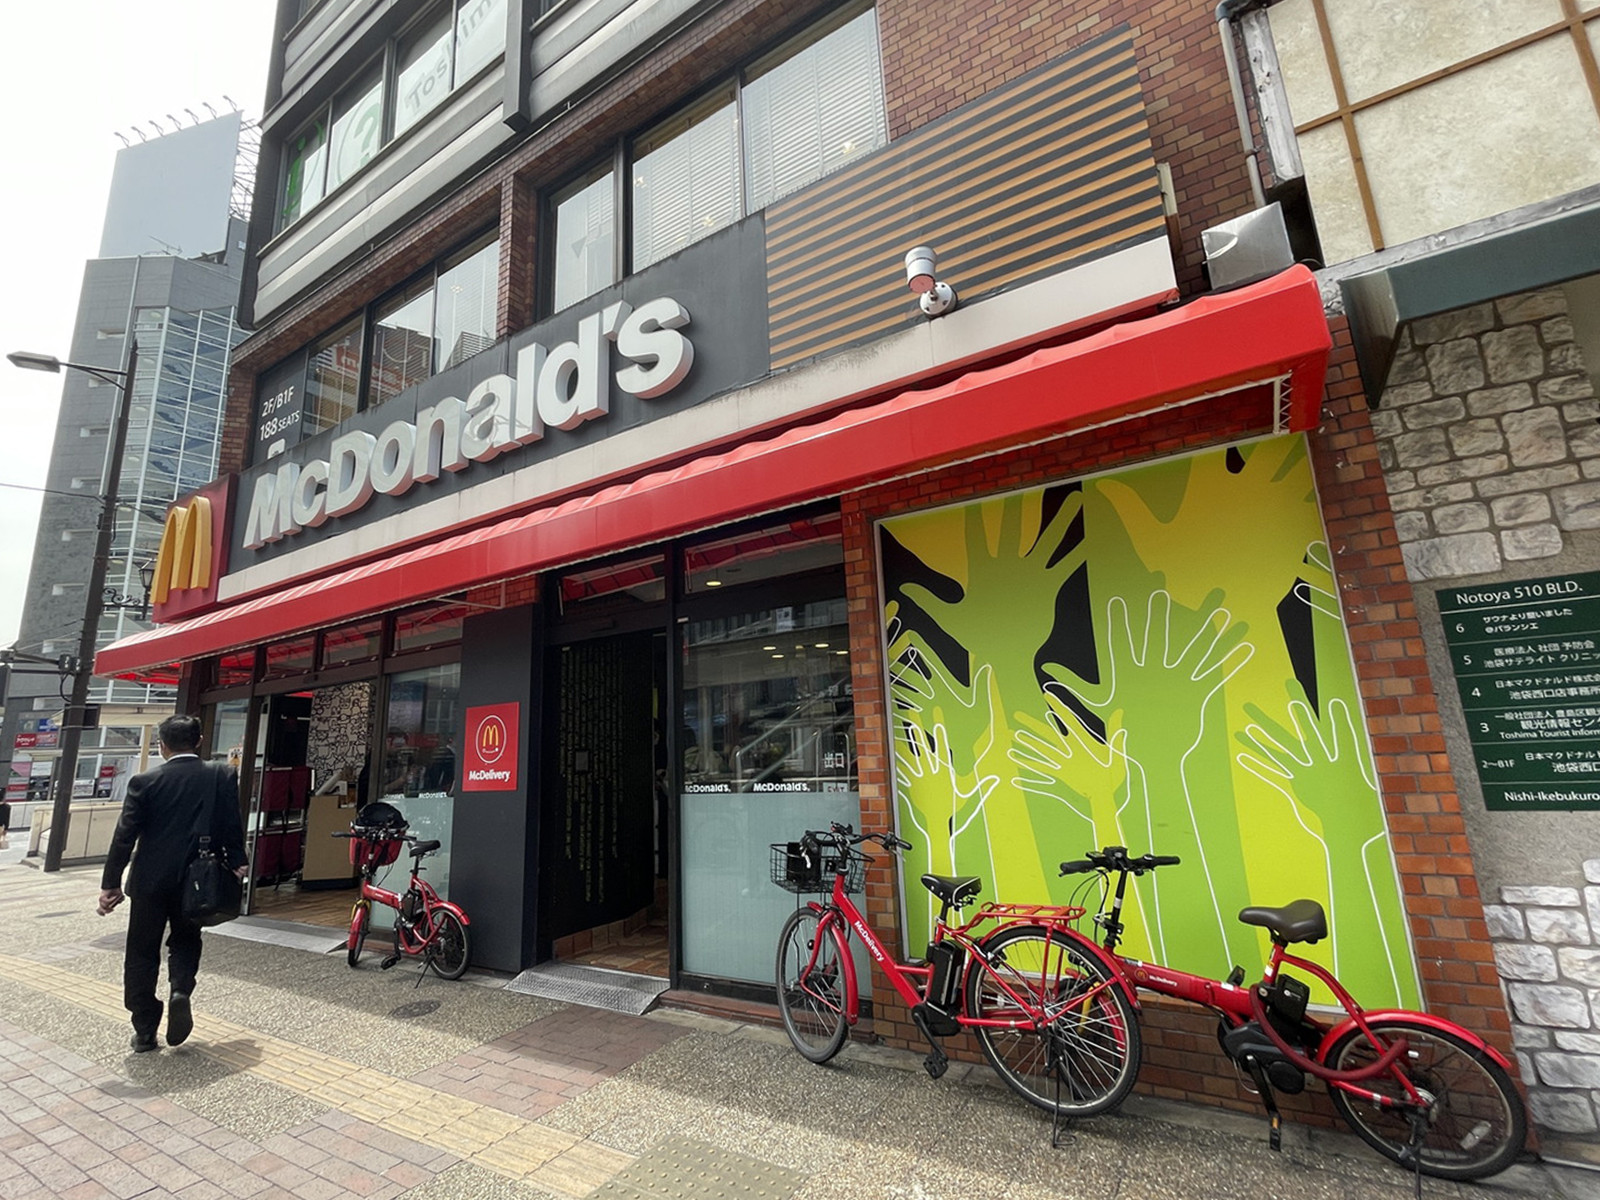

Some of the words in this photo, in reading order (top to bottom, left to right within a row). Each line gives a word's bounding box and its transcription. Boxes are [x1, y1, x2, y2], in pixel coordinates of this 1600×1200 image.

[403, 0, 494, 108] Tosim
[261, 386, 295, 417] 2F/B1F
[243, 296, 695, 550] McDonald's
[260, 417, 278, 441] 188
[278, 410, 300, 432] SEATS
[1456, 590, 1511, 604] Notoya
[1514, 584, 1543, 598] 510
[1546, 580, 1583, 595] BLD.
[1455, 623, 1465, 633] 6
[1463, 654, 1472, 665] 5
[1471, 687, 1481, 698] 4
[1480, 722, 1490, 733] 3
[1520, 717, 1600, 730] 観光情報セン
[1499, 730, 1538, 739] Toshima
[1538, 729, 1570, 738] Tourist
[468, 768, 511, 782] McDelivery
[854, 920, 885, 961] McDelivery
